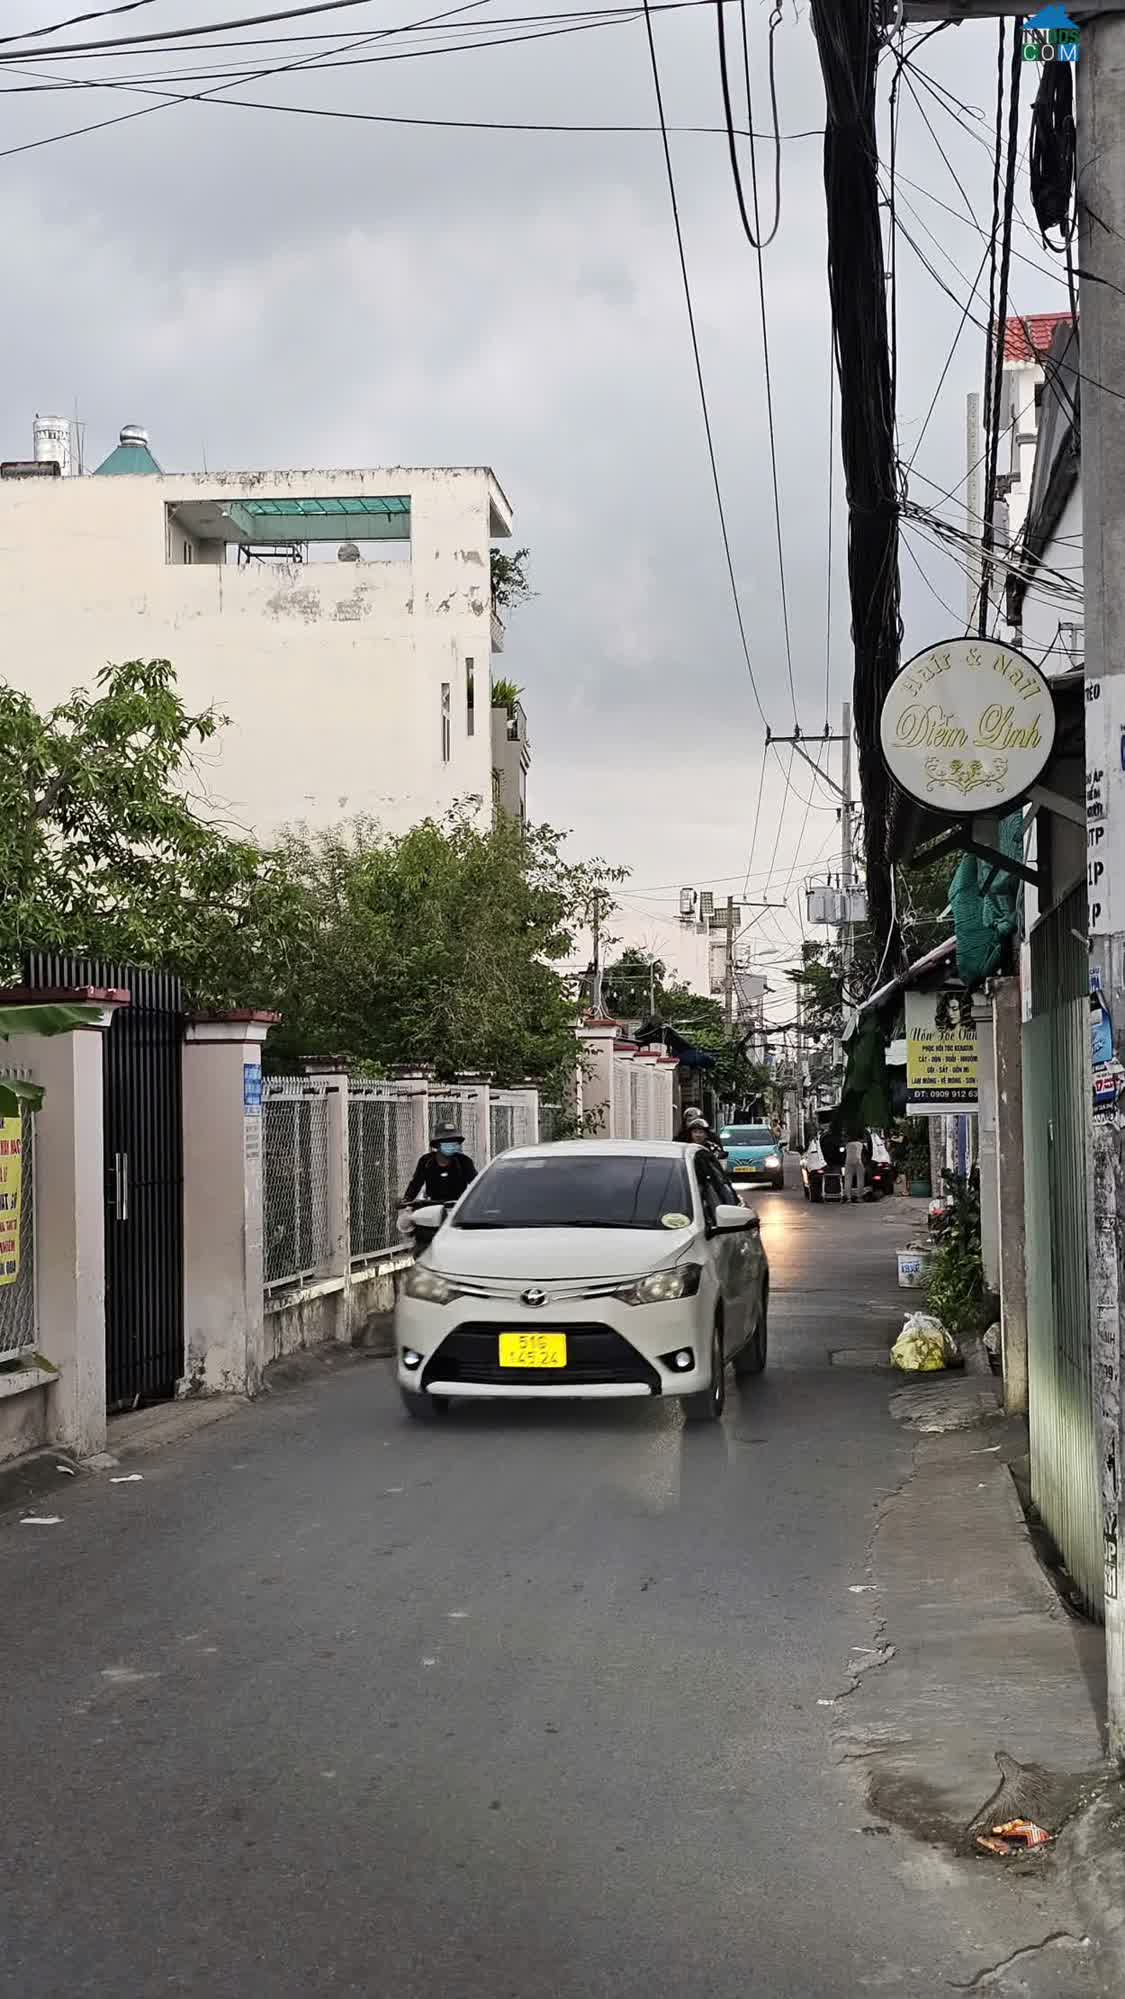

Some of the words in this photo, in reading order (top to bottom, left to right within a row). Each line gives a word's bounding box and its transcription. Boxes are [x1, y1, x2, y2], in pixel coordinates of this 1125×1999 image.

[902, 653, 952, 697] Hair
[966, 647, 982, 666] &
[993, 654, 1042, 700] Nail
[972, 703, 1043, 751] Linh
